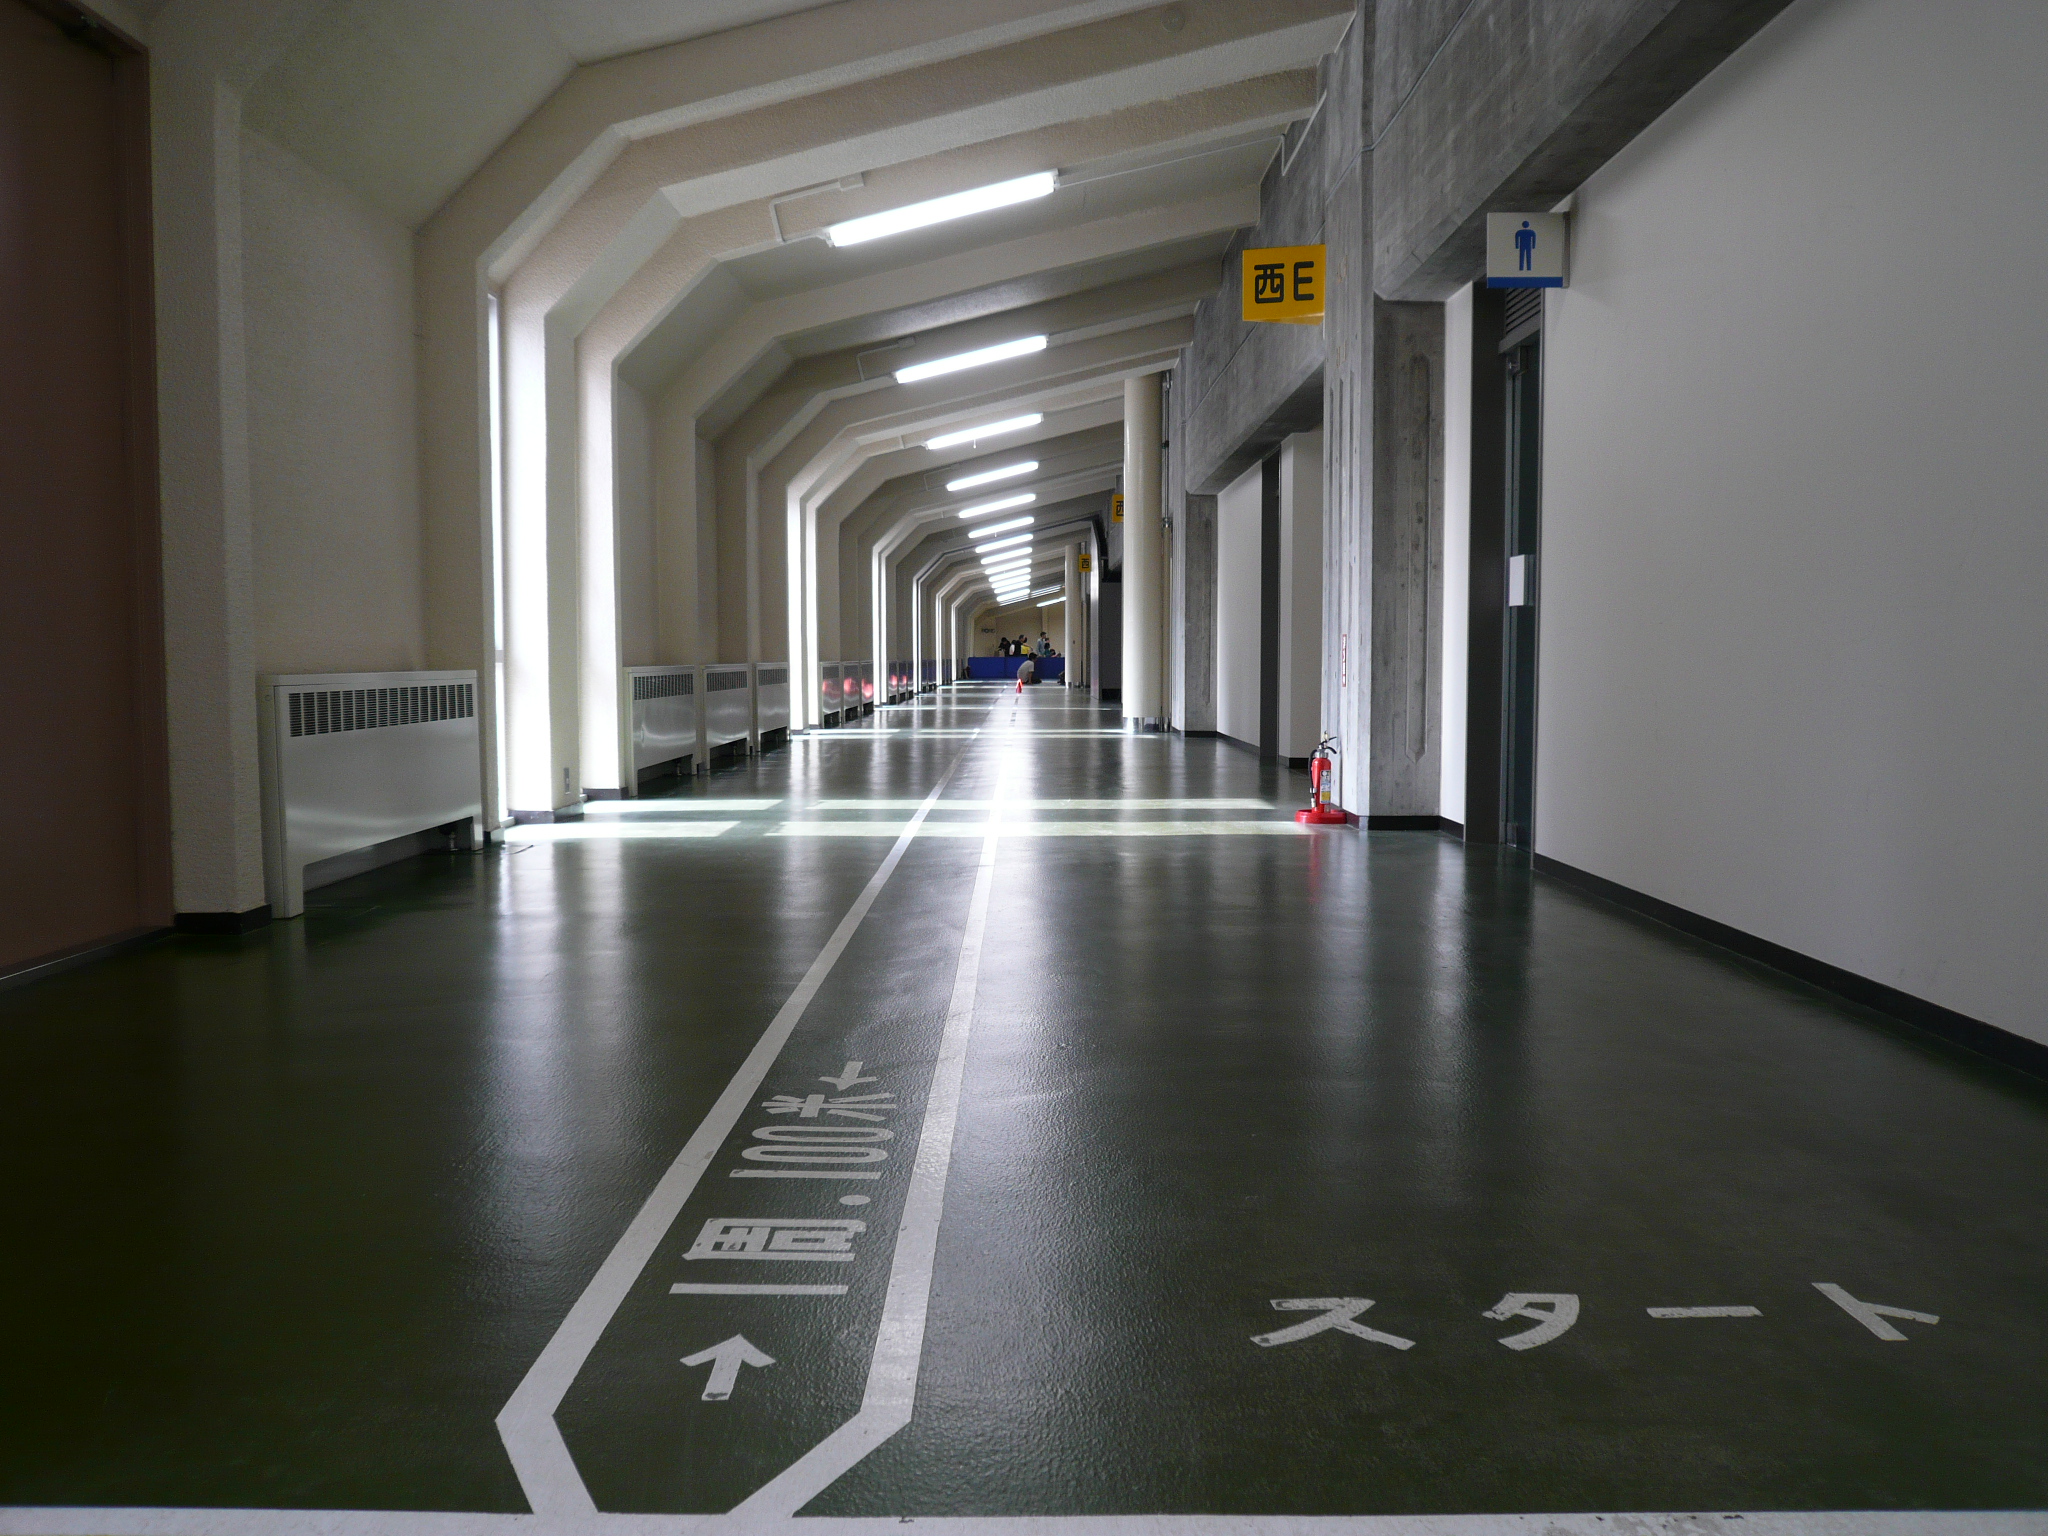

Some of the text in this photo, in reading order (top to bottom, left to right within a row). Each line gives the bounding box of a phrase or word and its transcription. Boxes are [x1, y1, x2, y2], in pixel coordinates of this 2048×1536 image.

[1254, 261, 1314, 304] 西E
[1250, 1281, 1940, 1351] スタート
